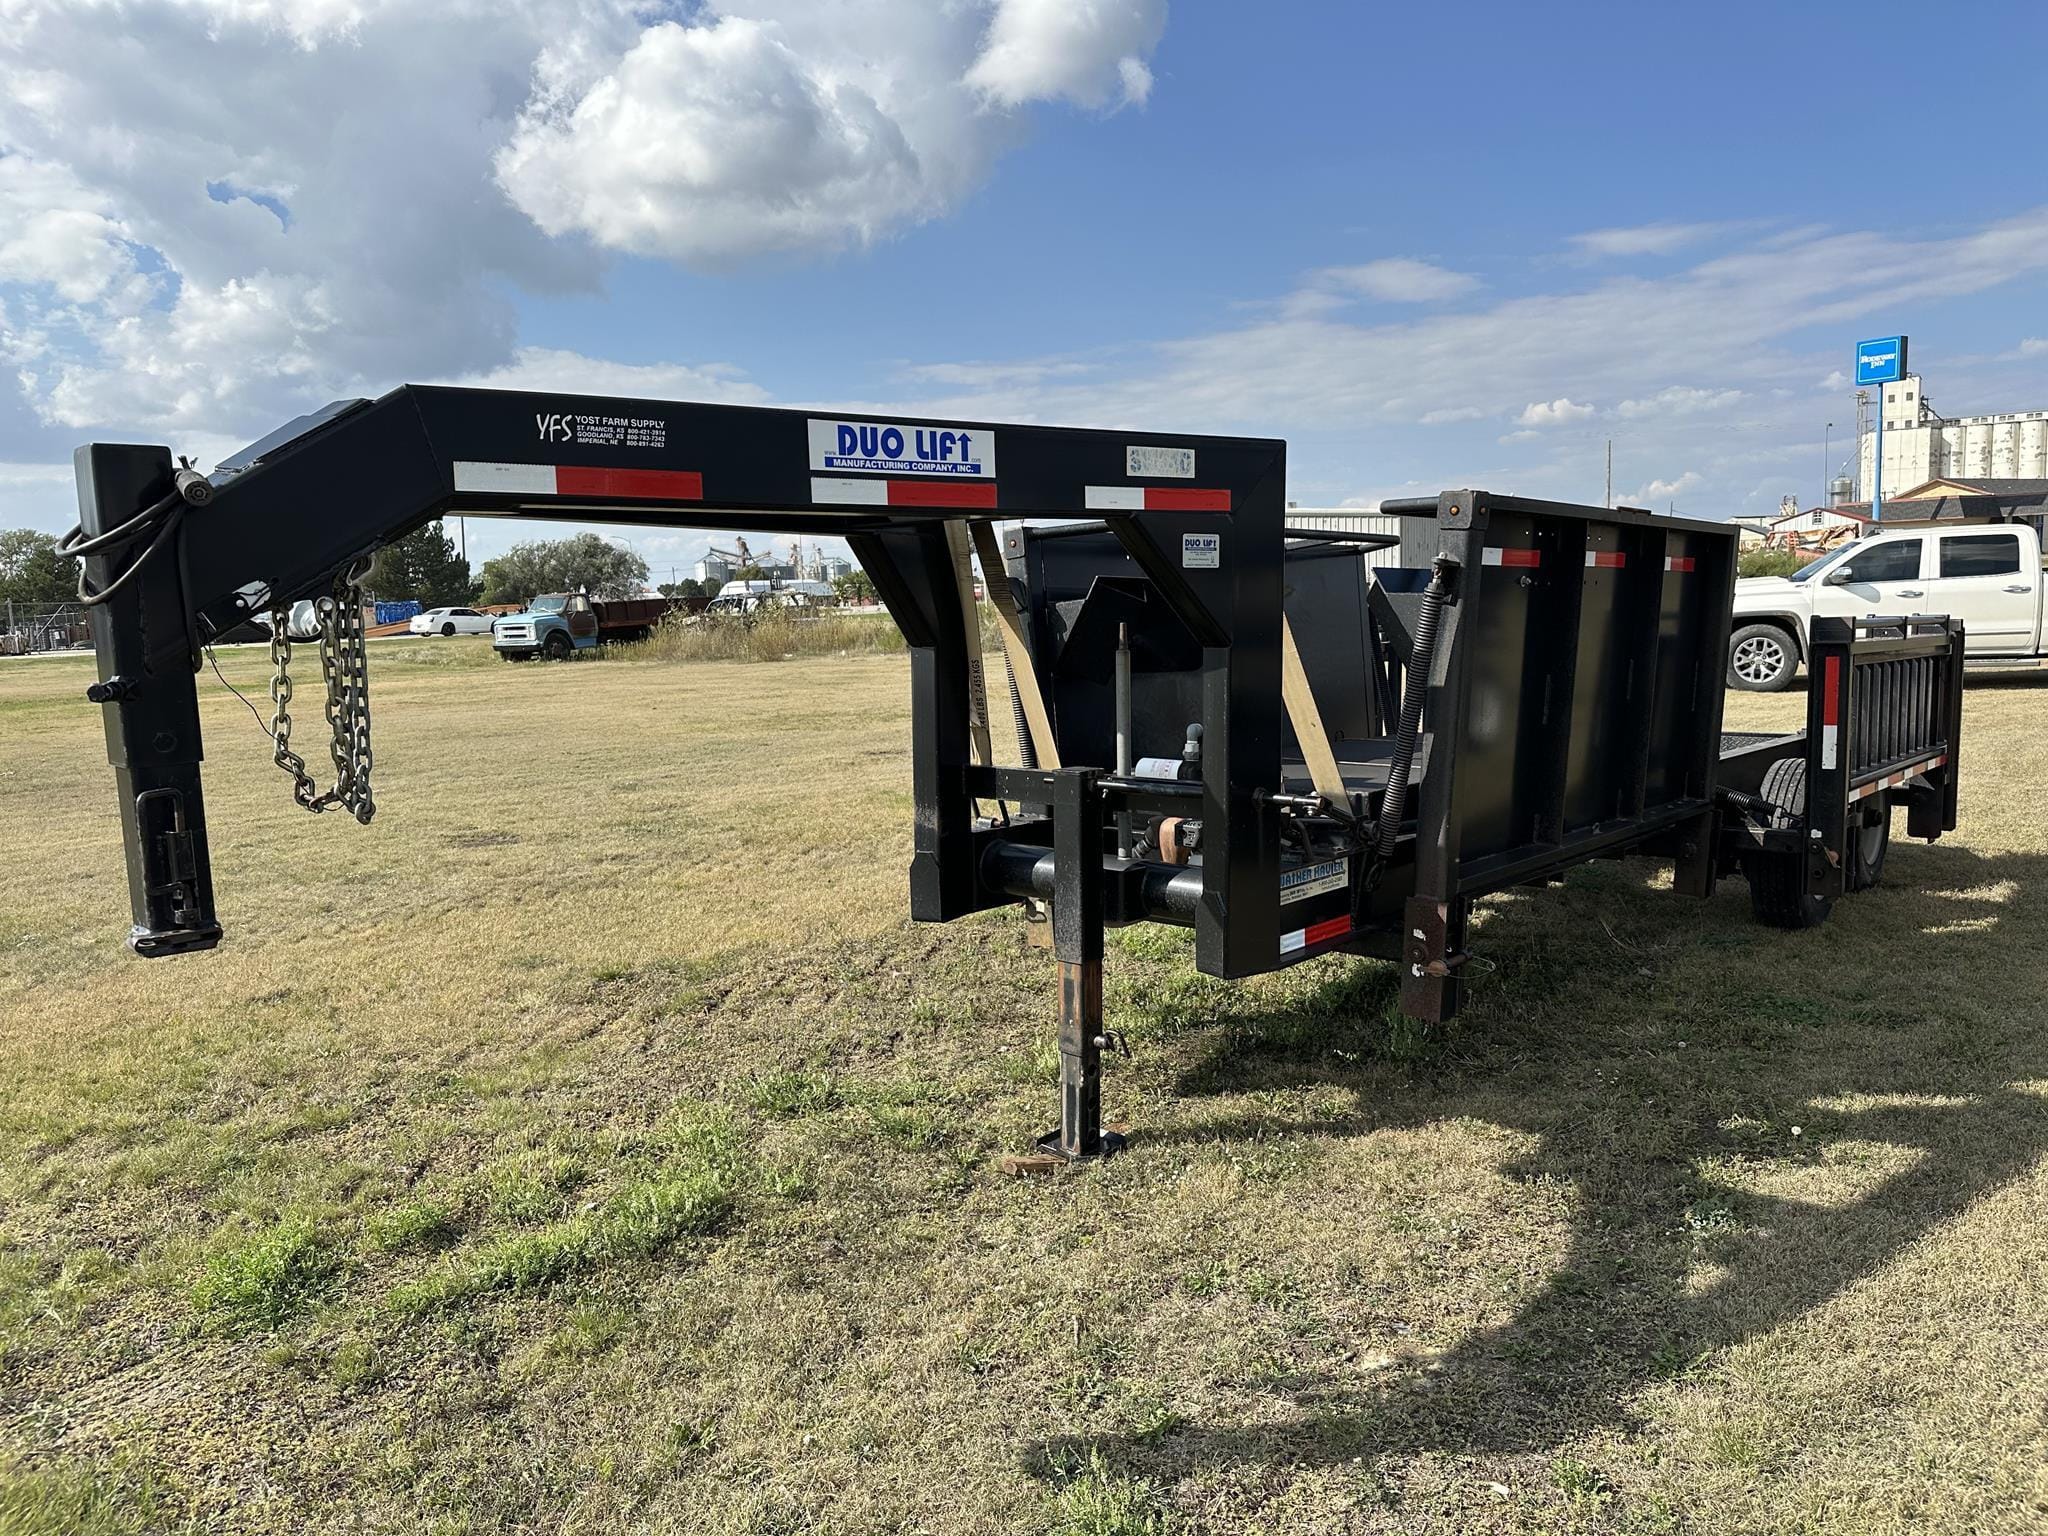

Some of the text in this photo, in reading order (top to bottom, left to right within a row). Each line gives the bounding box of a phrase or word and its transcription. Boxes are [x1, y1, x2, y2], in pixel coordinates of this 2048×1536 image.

[536, 413, 573, 443] YFS
[575, 415, 665, 429] YOST FARM SUPPLY
[838, 424, 904, 459] DUO
[916, 429, 972, 462] LIFT
[833, 458, 974, 473] MANUFACTURING COMPANY, INC.
[1185, 539, 1202, 547] DUO
[971, 659, 981, 673] KGS
[975, 697, 985, 710] LBS
